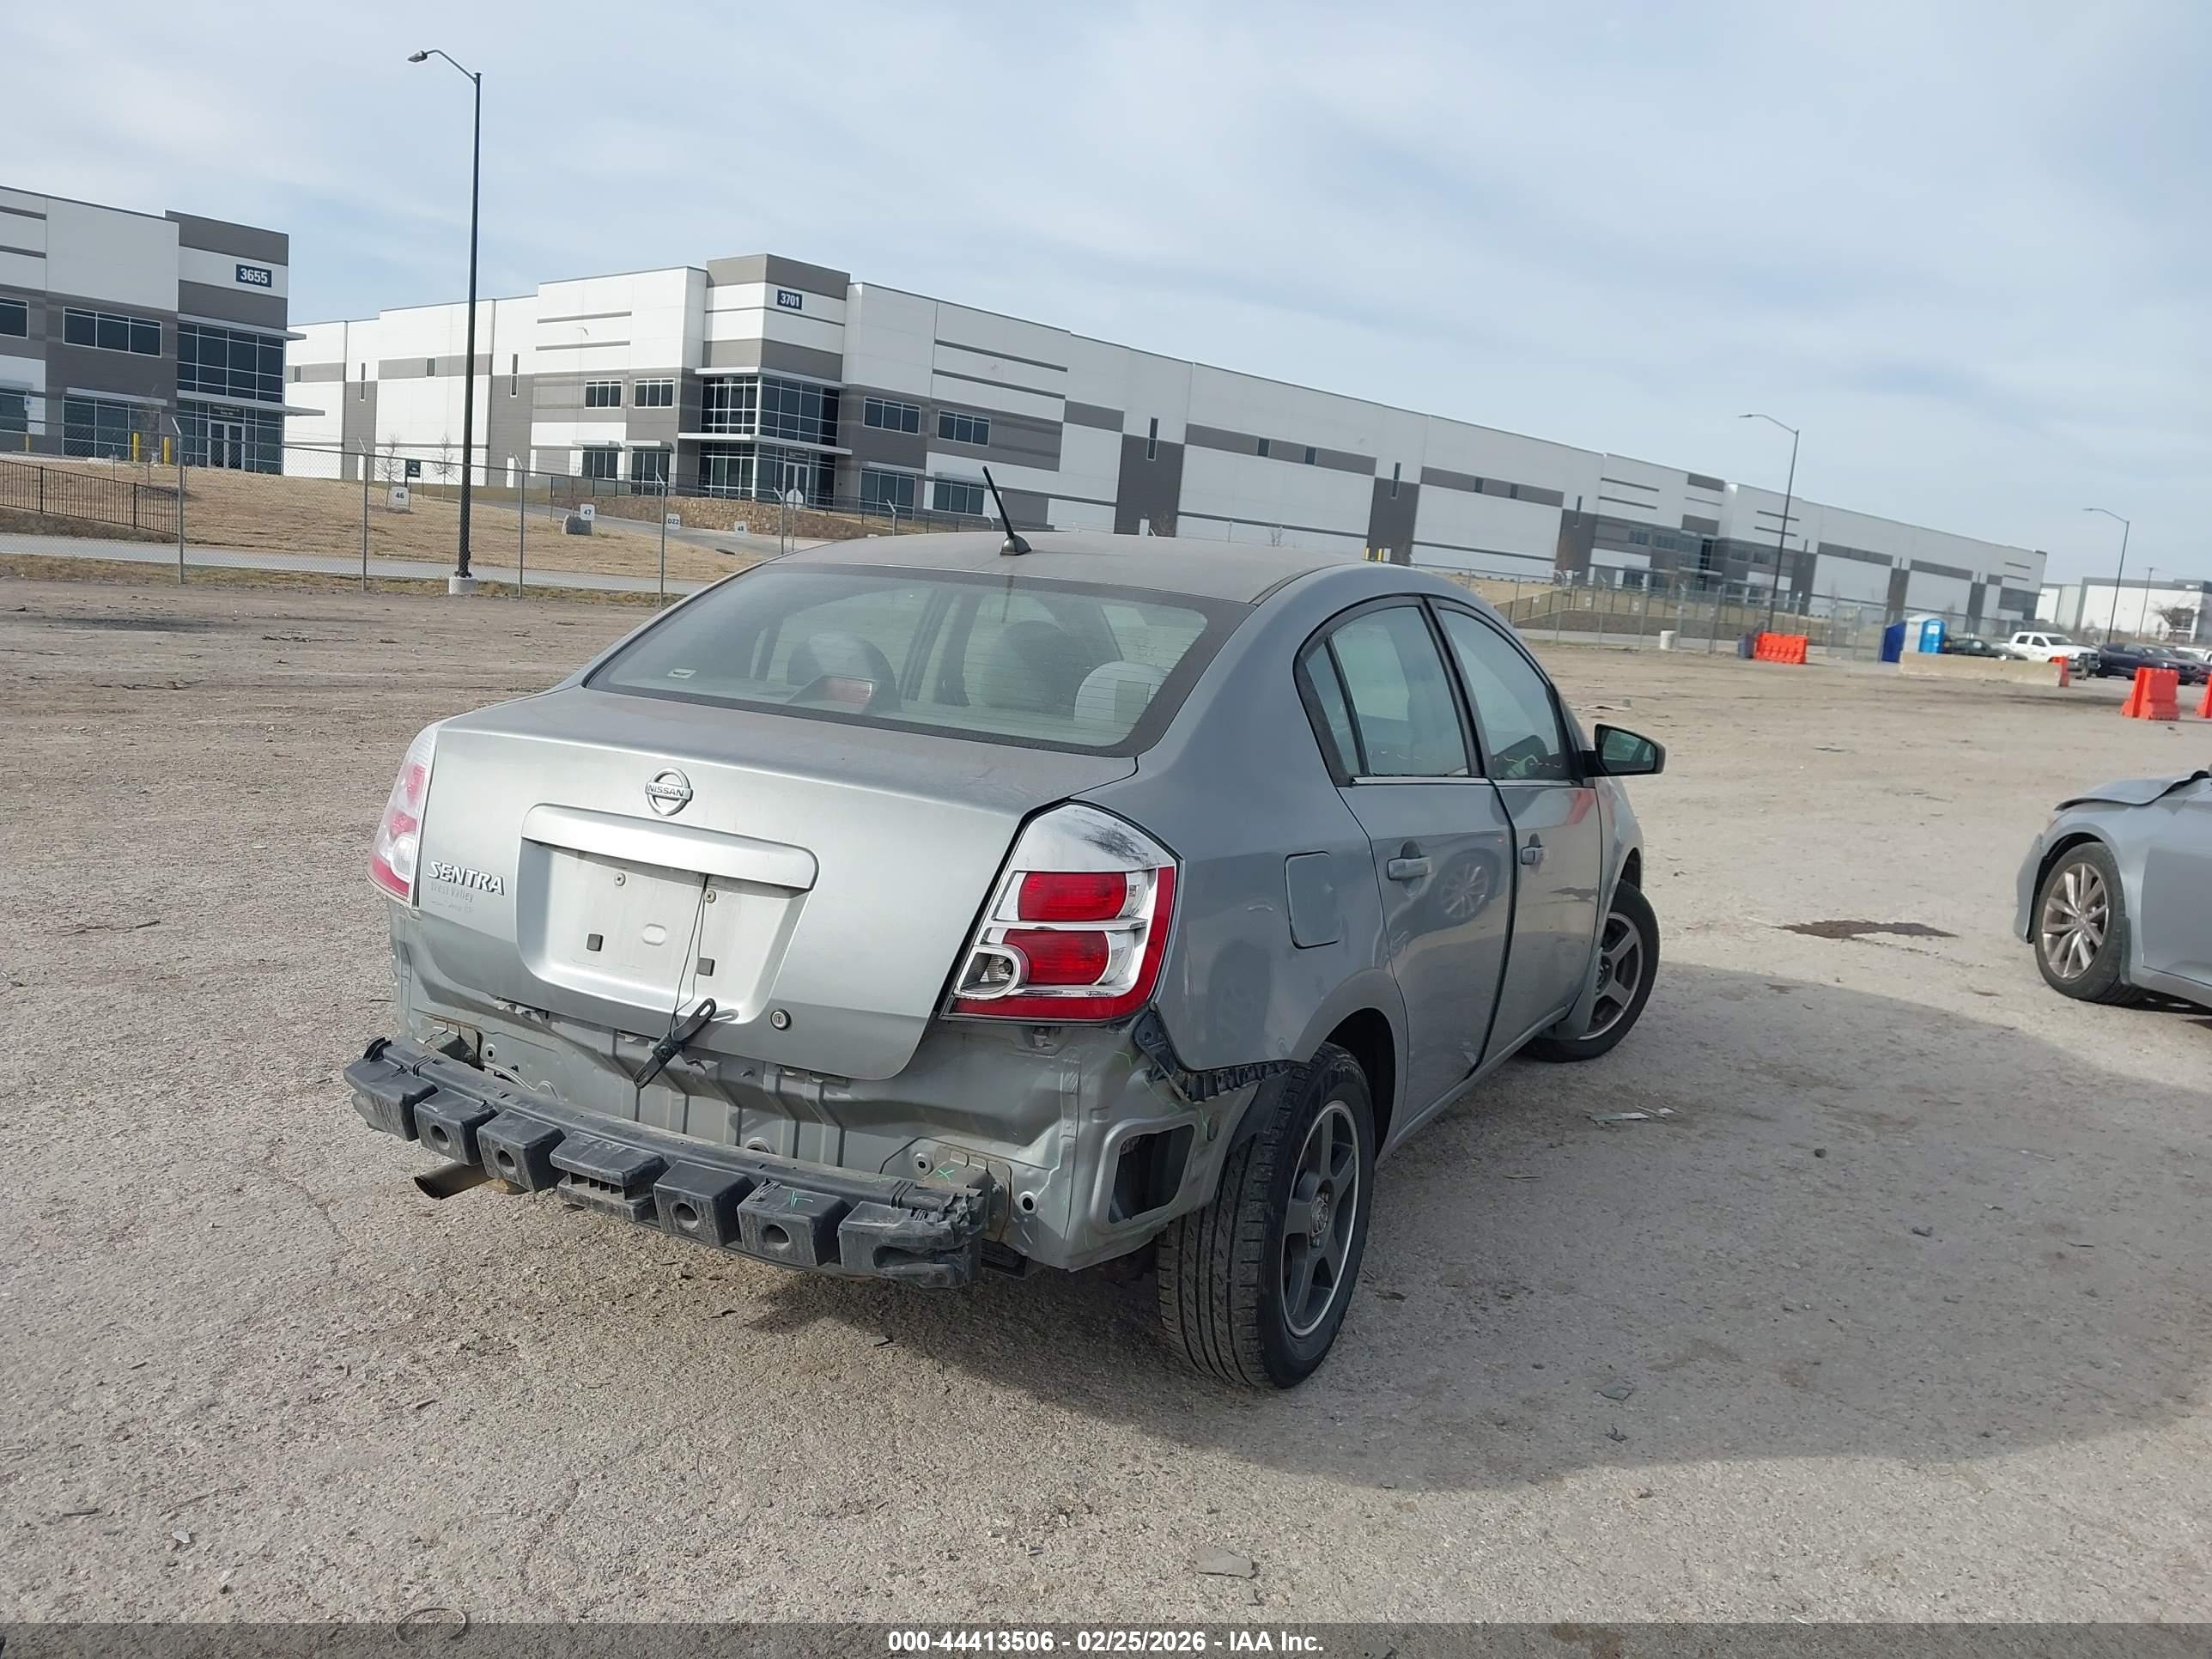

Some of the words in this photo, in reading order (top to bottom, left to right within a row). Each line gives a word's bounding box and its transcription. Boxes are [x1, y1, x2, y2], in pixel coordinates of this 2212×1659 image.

[240, 268, 268, 283] 3655
[781, 293, 799, 307] 3701
[647, 783, 684, 798] NISSAN
[428, 860, 505, 896] SENTRA
